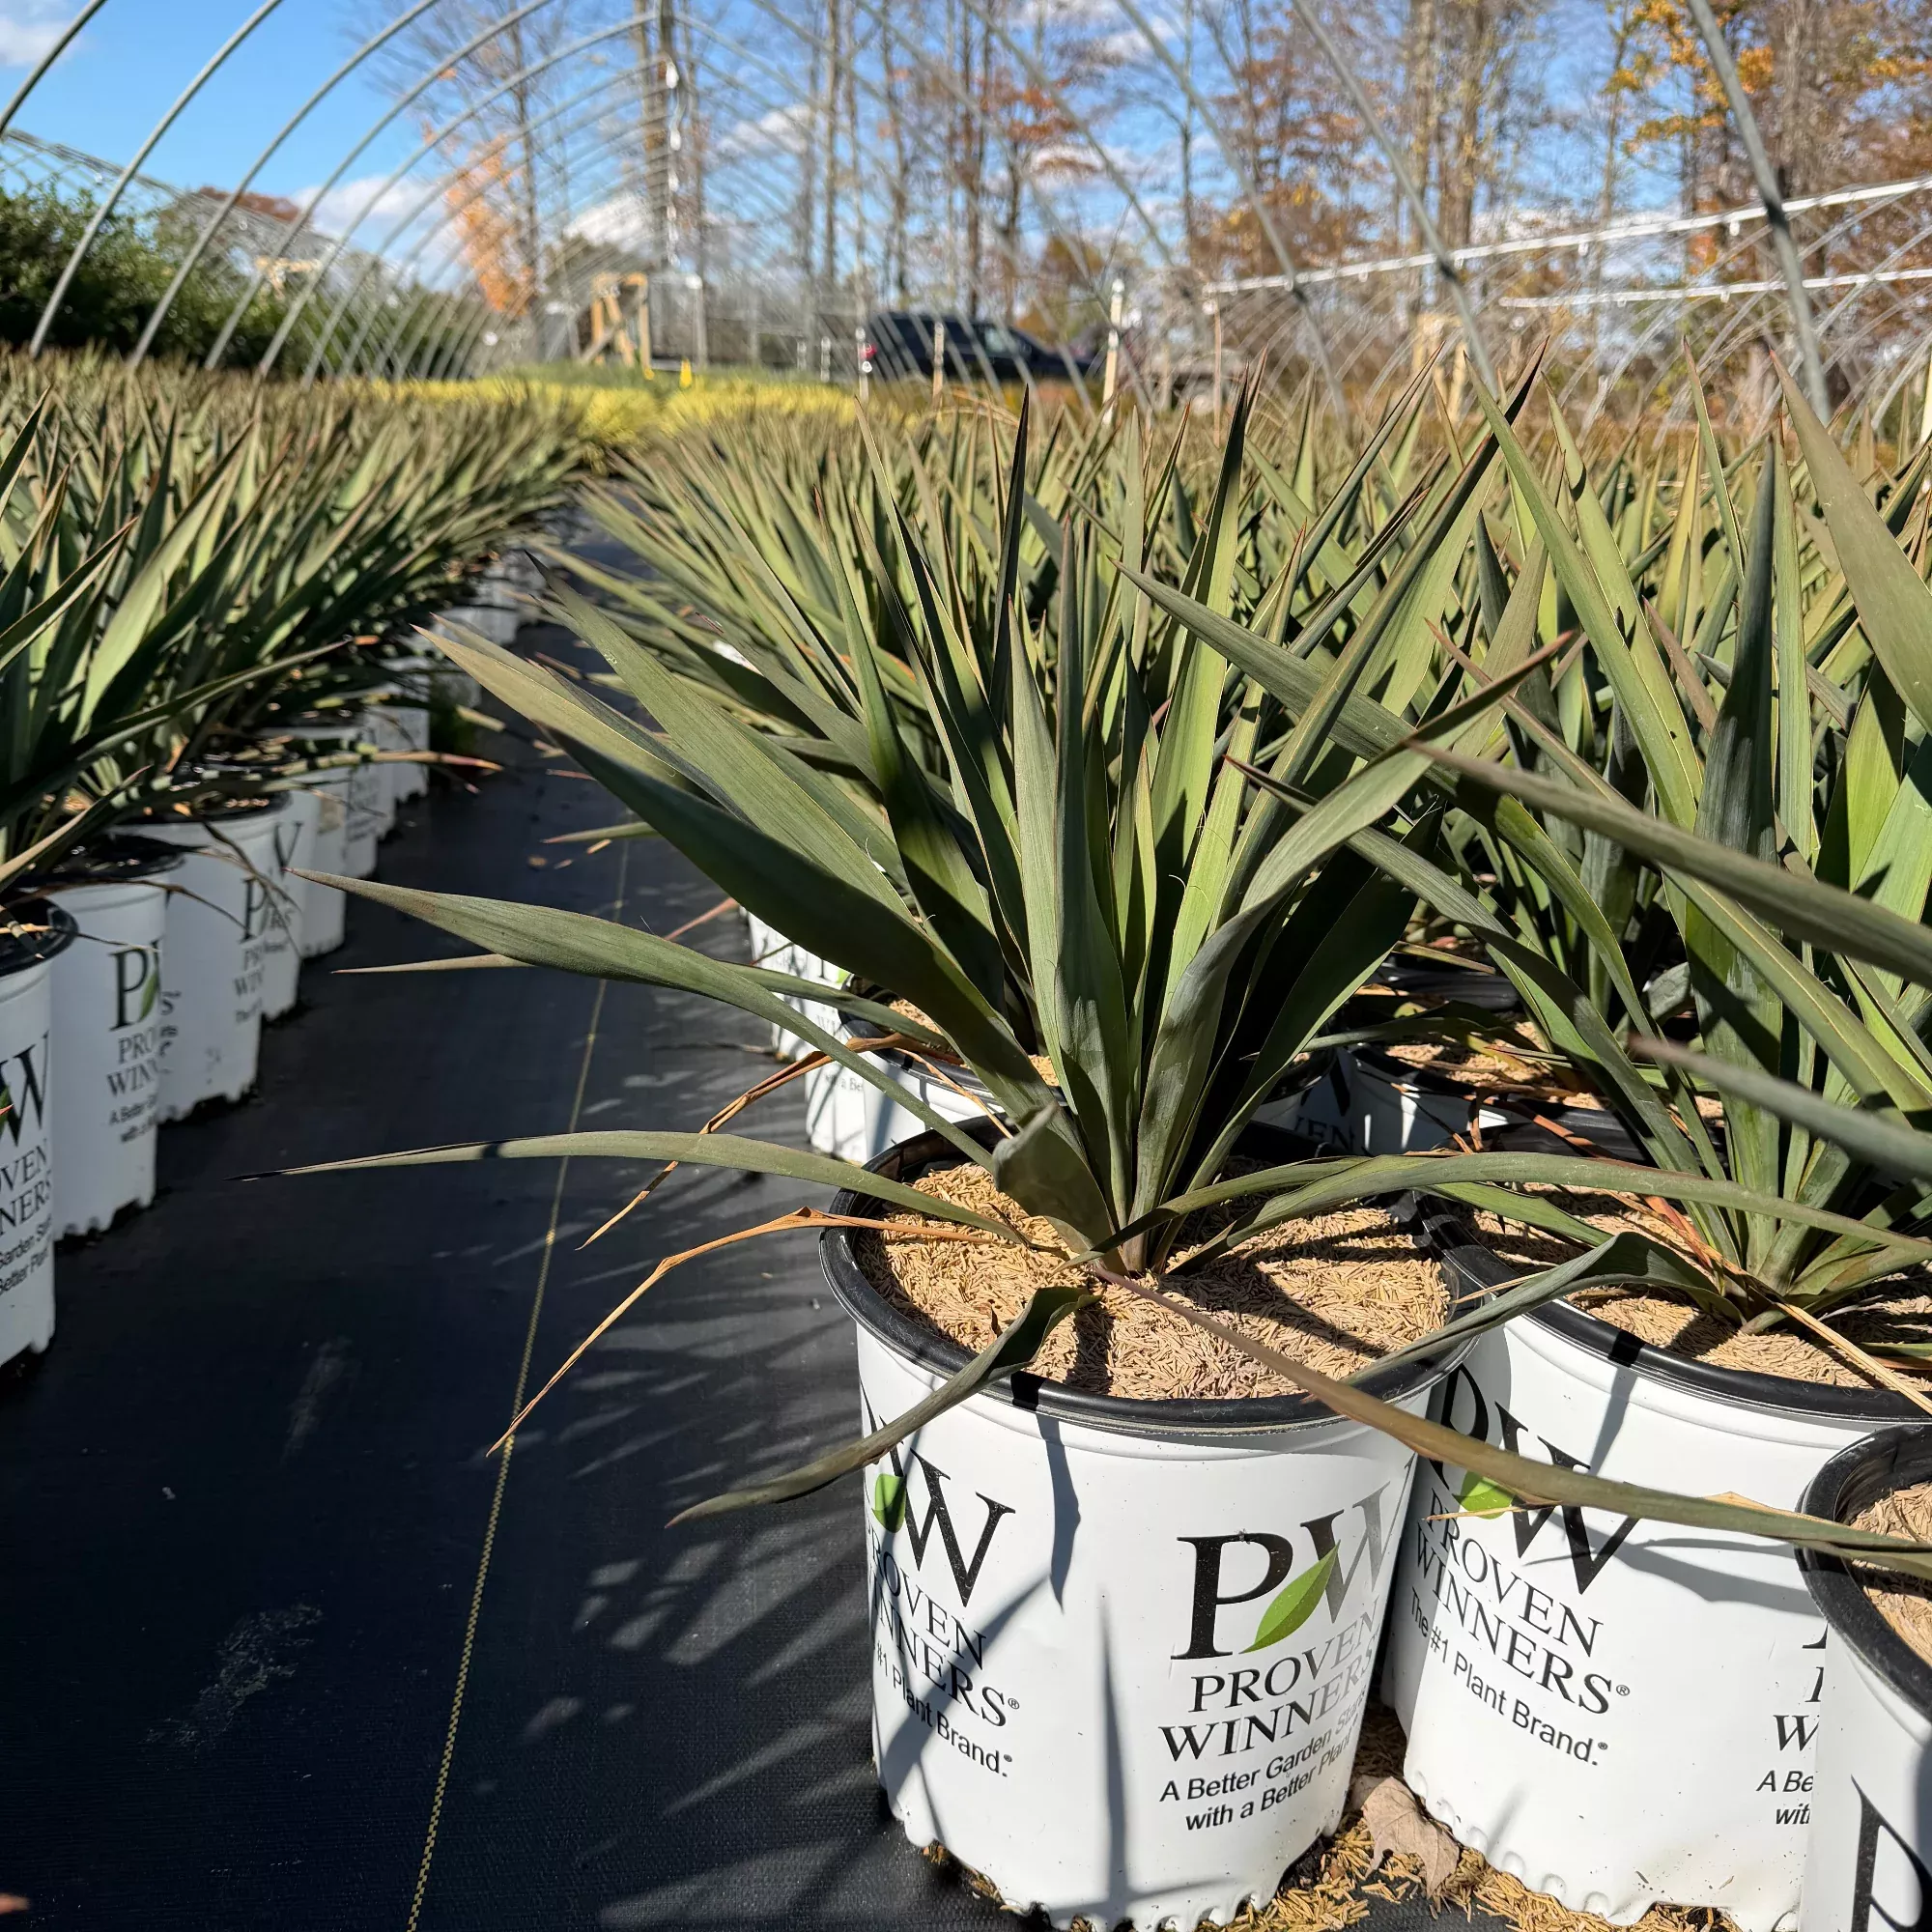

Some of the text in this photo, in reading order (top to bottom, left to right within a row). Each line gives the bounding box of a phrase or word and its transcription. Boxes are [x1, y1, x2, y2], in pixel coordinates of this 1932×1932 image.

[867, 1520, 987, 1670] ROVEN
[1170, 1463, 1410, 1661] PW
[1432, 1488, 1604, 1659] PROVEN
[867, 1562, 1020, 1727] INNERS®
[892, 1663, 933, 1727] Plant
[1187, 1594, 1380, 1713] PROVEN
[1411, 1586, 1429, 1638] The
[1430, 1625, 1449, 1663] #1
[1453, 1650, 1507, 1716] Plant
[1159, 1779, 1180, 1803] A
[1187, 1769, 1261, 1800] Better
[1265, 1727, 1332, 1779] Garden
[1185, 1803, 1235, 1831] with
[1240, 1801, 1255, 1819] a
[1260, 1767, 1317, 1811] Better
[1756, 1770, 1776, 1792] A
